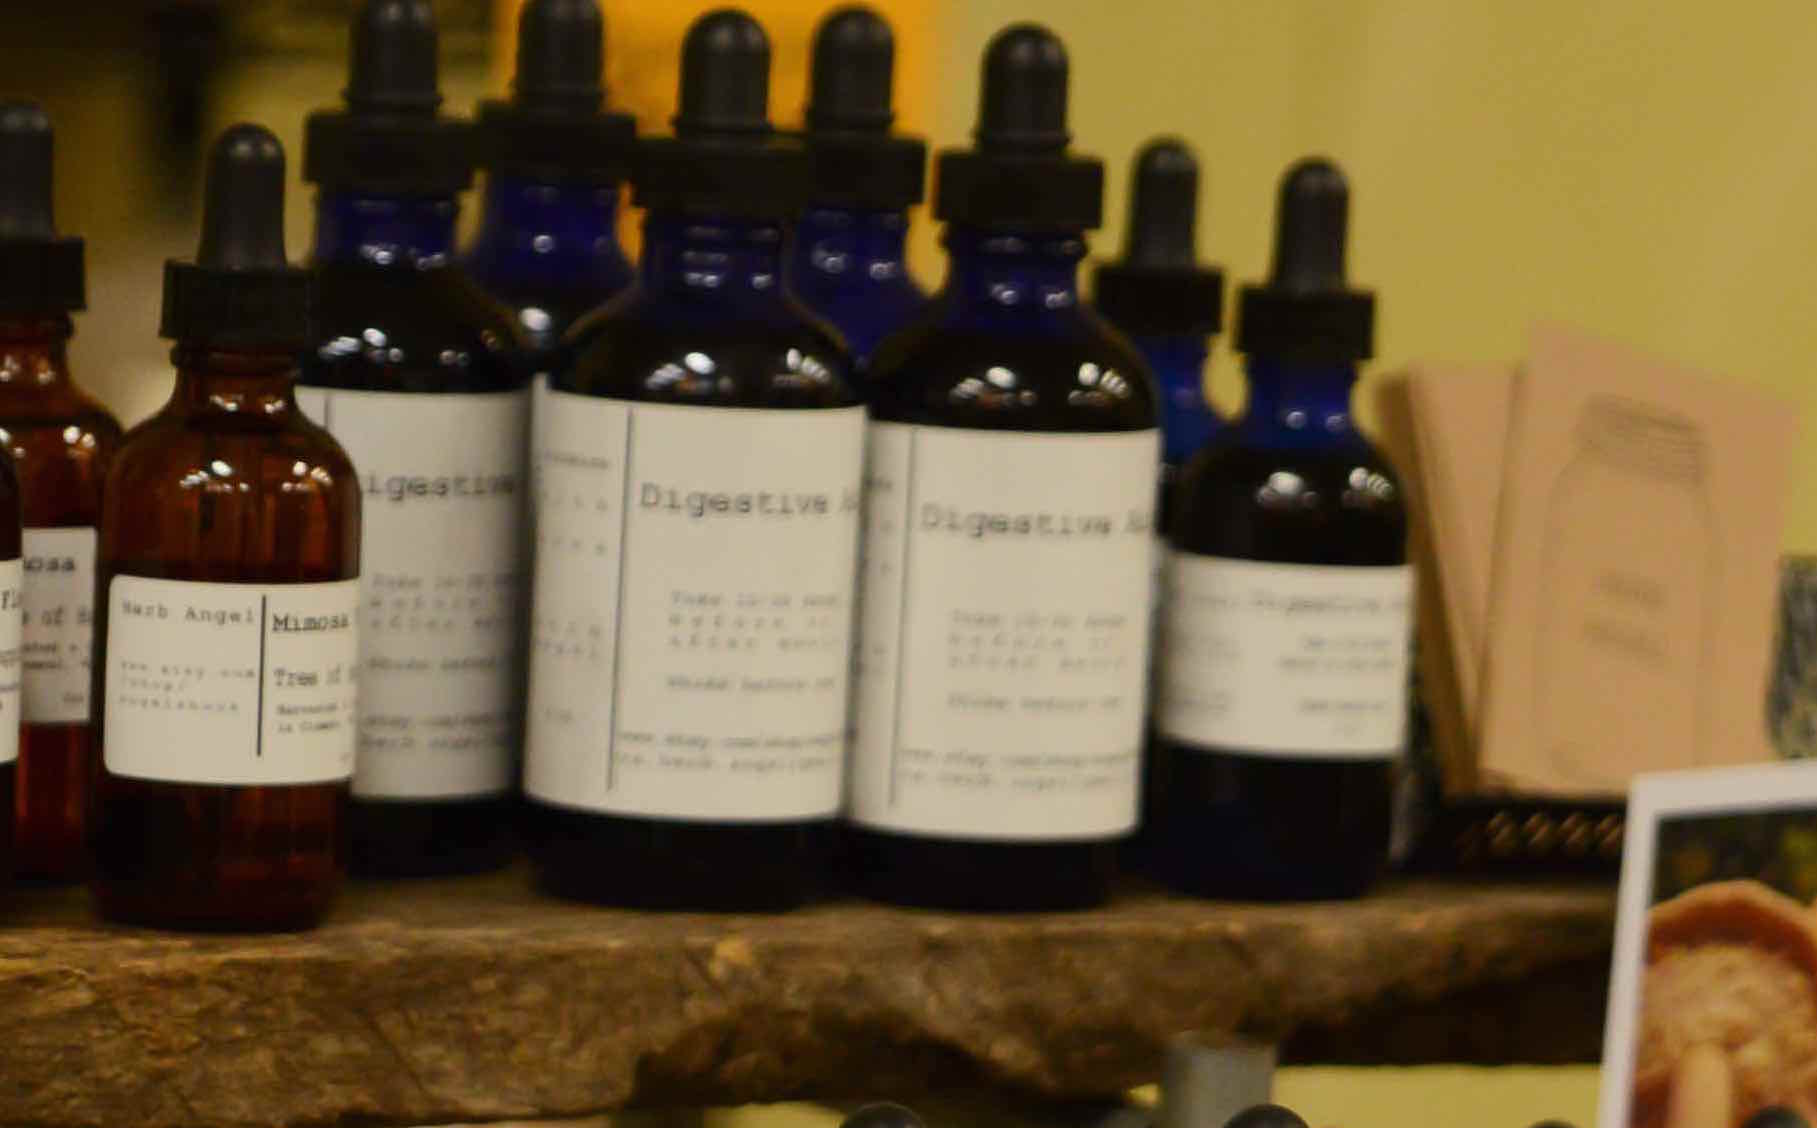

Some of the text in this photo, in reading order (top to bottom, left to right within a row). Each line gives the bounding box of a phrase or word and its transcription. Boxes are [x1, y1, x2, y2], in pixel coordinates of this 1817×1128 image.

[640, 481, 830, 519] Digestive
[920, 503, 1112, 538] Digestive
[184, 605, 254, 625] Angel
